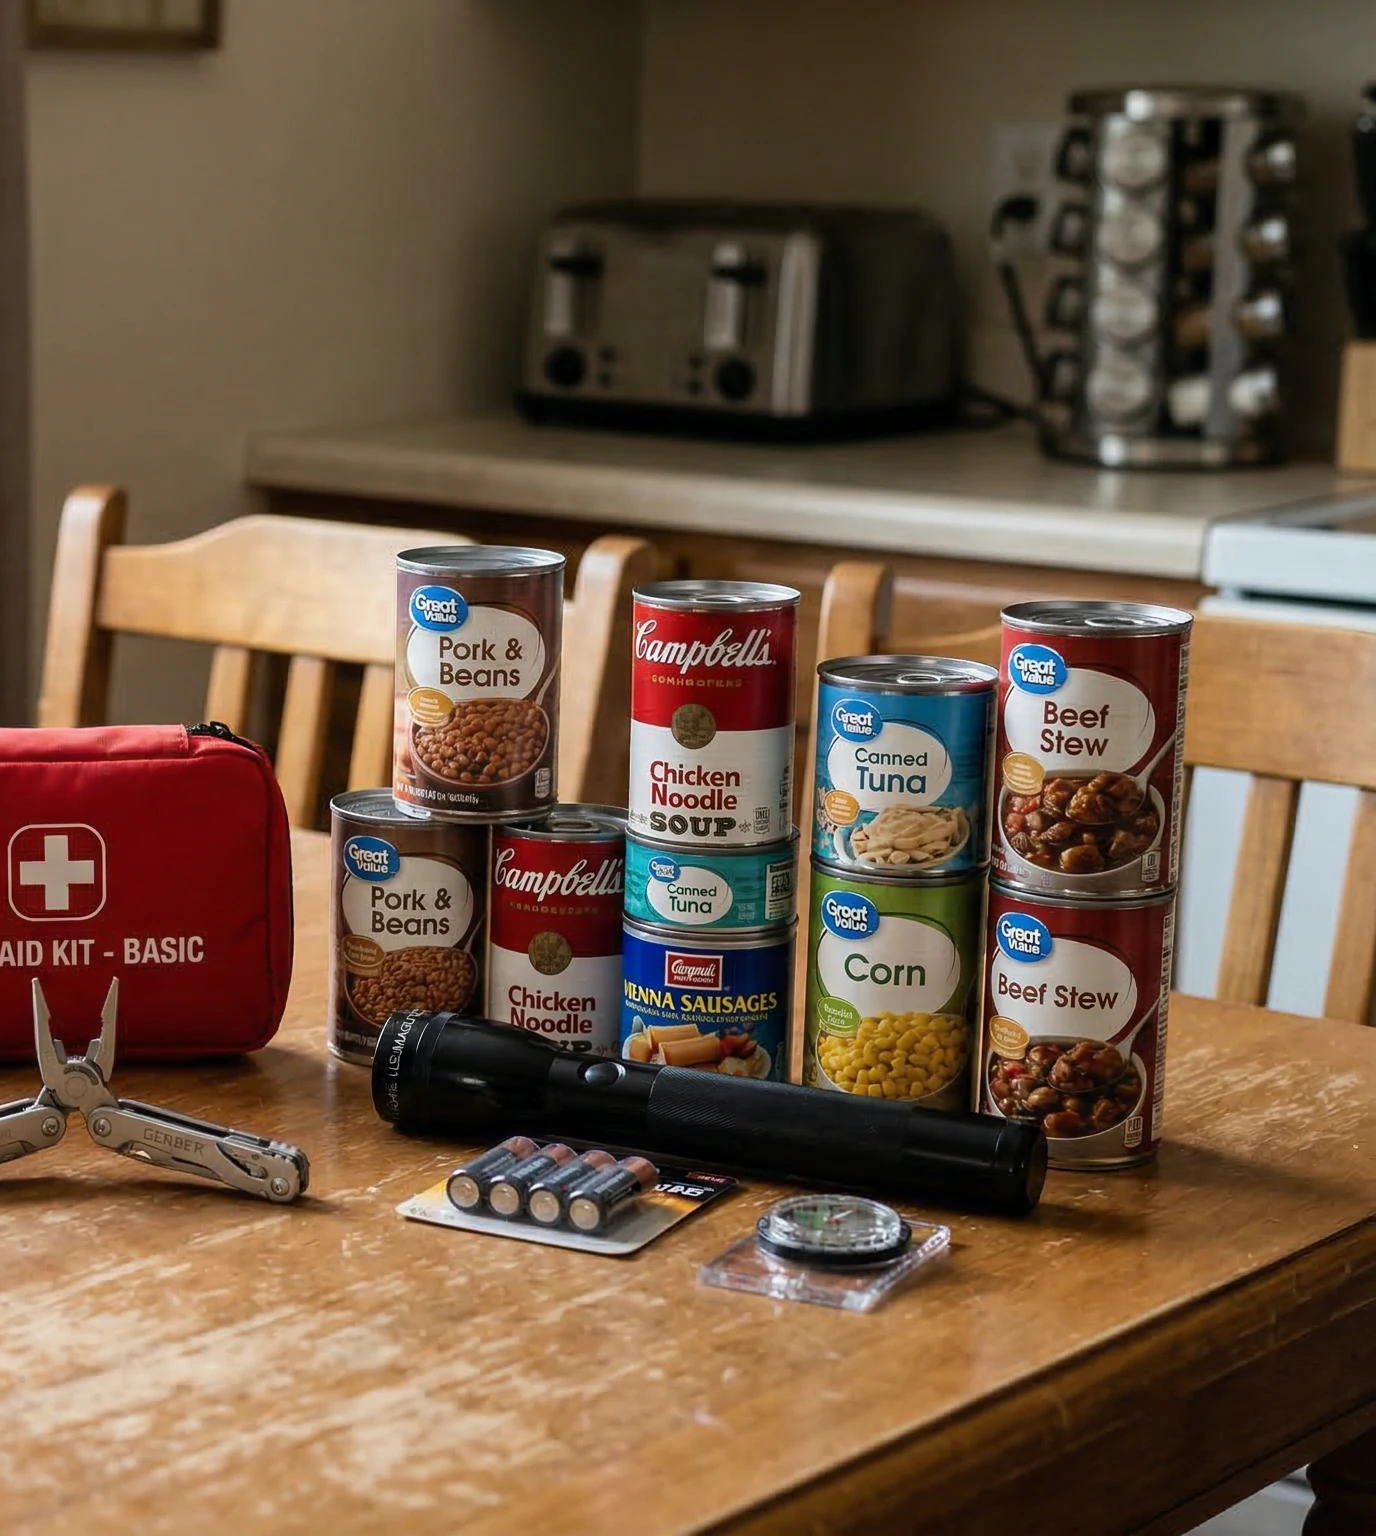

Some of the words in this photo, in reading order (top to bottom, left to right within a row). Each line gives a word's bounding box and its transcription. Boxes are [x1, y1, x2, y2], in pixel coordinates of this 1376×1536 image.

[439, 636, 496, 661] Pork
[505, 638, 523, 660] &
[635, 618, 774, 674] Campbell's
[439, 662, 520, 687] Beans
[1014, 652, 1056, 675] Great
[1043, 700, 1110, 729] Beef
[1040, 728, 1110, 757] Stew
[855, 747, 928, 767] Canned
[650, 760, 741, 788] Chicken
[856, 766, 927, 794] Tuna
[651, 783, 738, 810] Noodle
[649, 811, 737, 837] SOUP
[494, 848, 624, 902] Campbell's
[371, 886, 426, 911] Pork
[434, 888, 452, 910] &
[667, 883, 717, 897] Canned
[669, 896, 713, 914] Tuna
[371, 911, 450, 935] Beans
[1001, 920, 1041, 945] Great
[52, 939, 95, 966] KIT
[125, 936, 205, 964] BASIC
[844, 953, 926, 986] Corn
[508, 984, 596, 1012] Chicken
[680, 992, 777, 1014] SAUSAGES
[998, 973, 1048, 1005] Beef
[1054, 984, 1119, 1010] Stew
[510, 1006, 593, 1034] Noodle
[143, 1128, 205, 1154] GERBER
